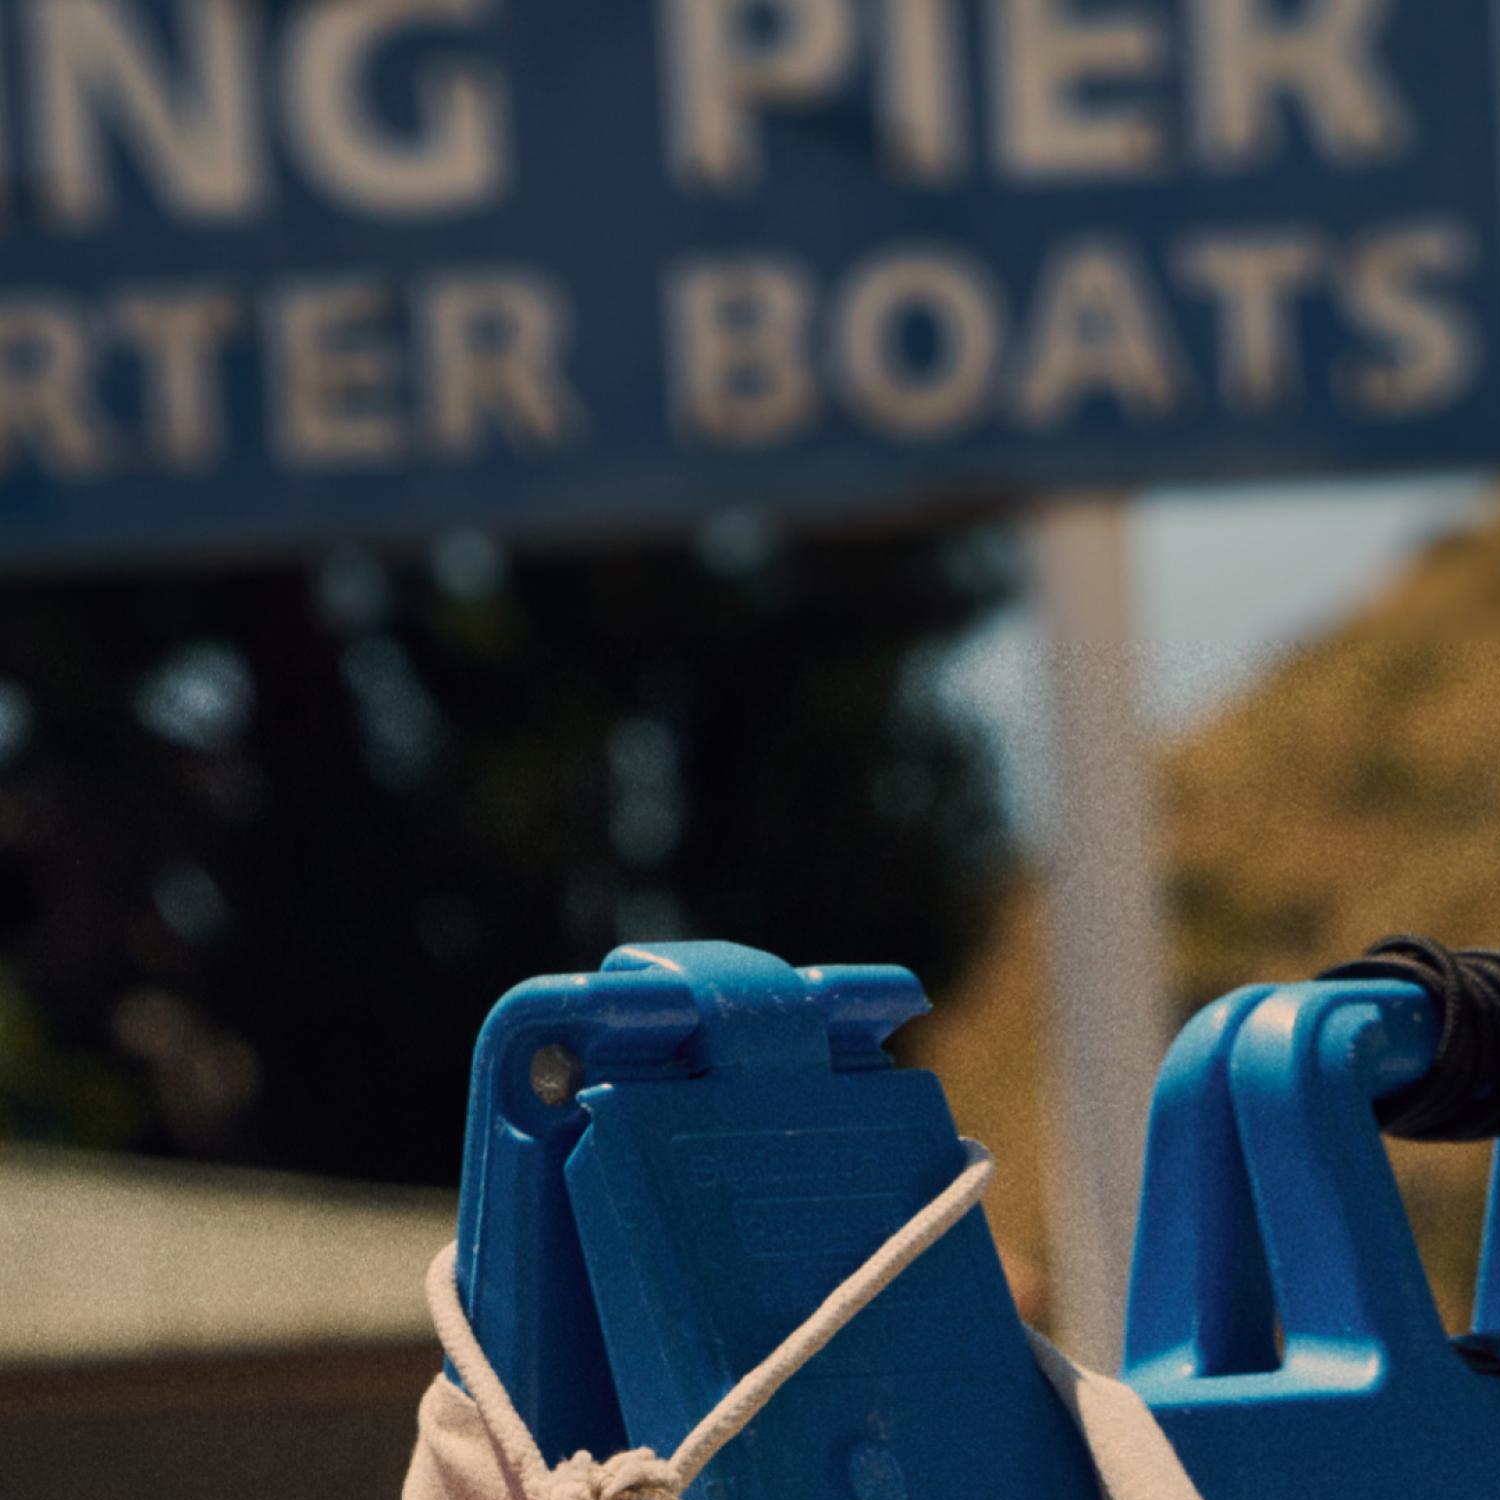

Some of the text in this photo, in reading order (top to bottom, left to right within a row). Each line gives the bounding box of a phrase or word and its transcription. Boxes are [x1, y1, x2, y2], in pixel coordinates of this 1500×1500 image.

[0, 0, 1396, 220] NG PIER
[0, 226, 1468, 465] RTER BOATS
